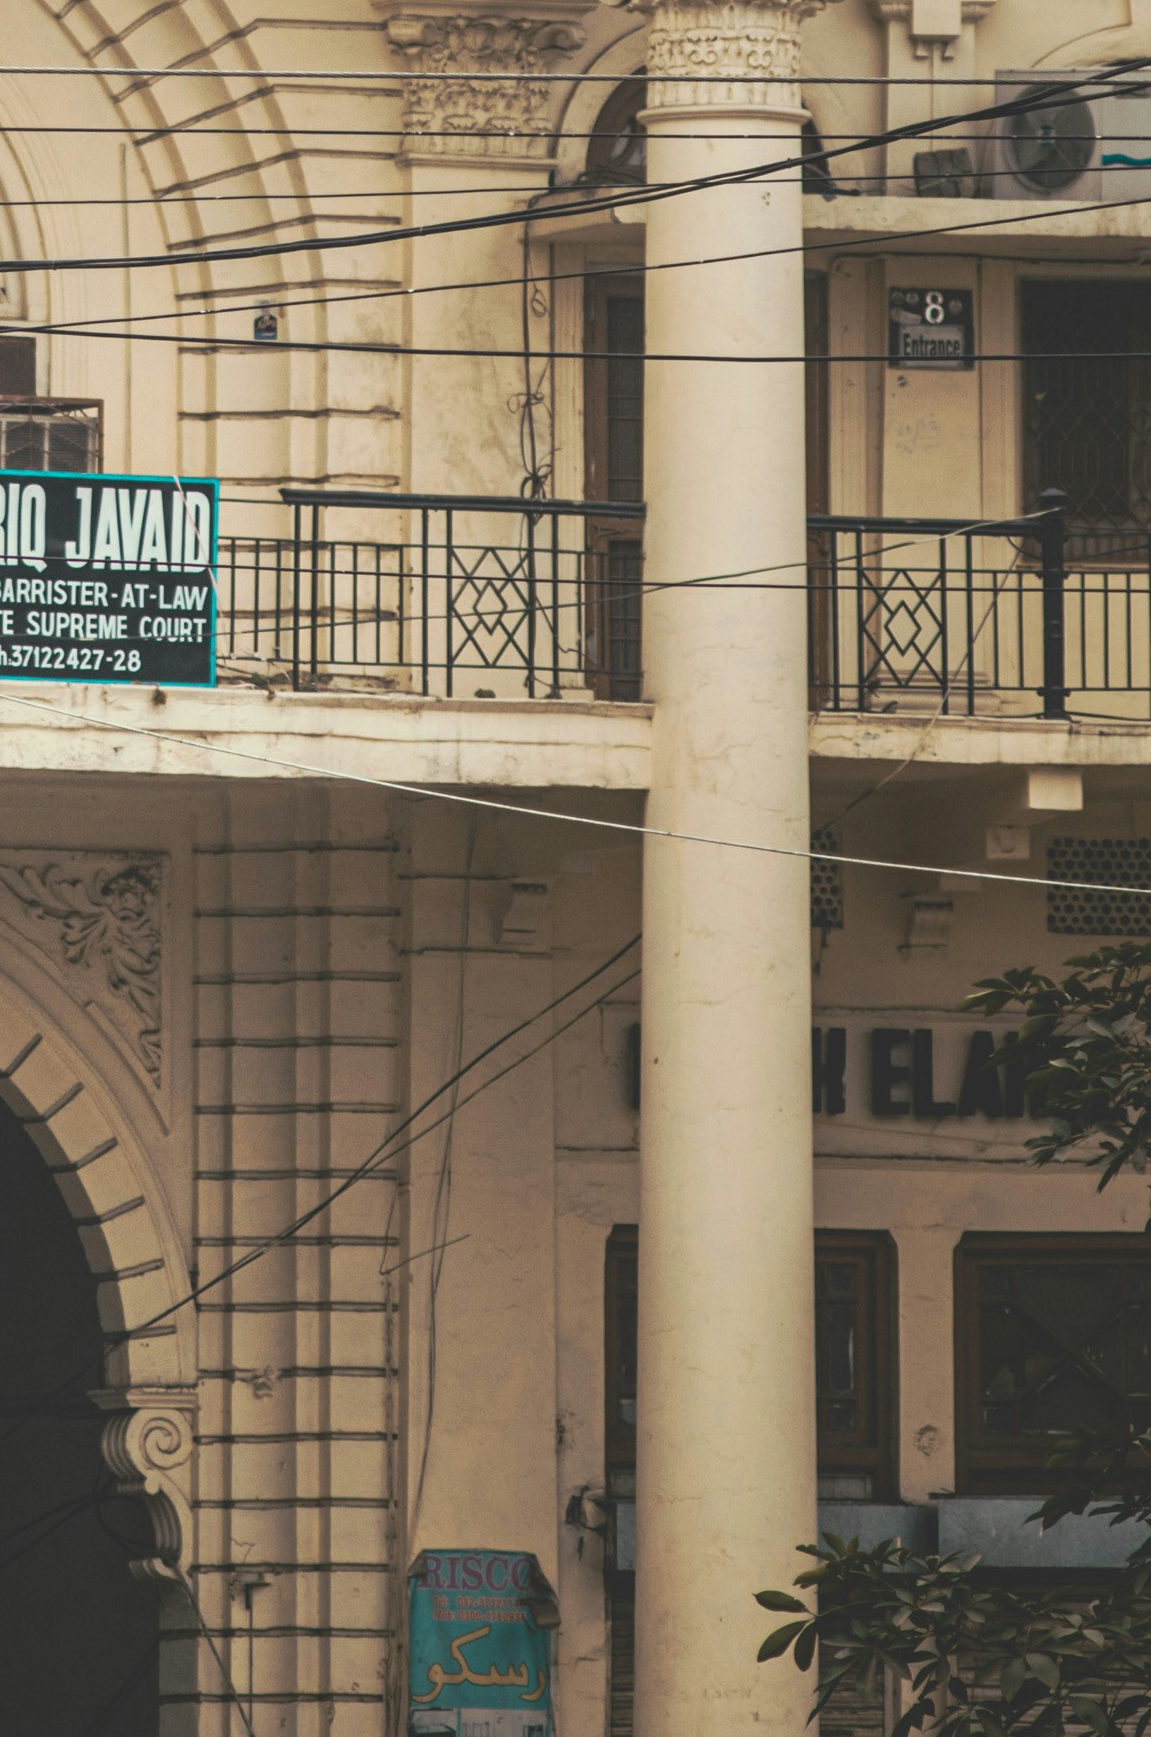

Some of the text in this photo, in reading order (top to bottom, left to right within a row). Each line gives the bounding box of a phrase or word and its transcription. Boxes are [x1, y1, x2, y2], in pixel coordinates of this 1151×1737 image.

[925, 291, 945, 324] 8
[903, 333, 961, 357] Entrance
[65, 486, 211, 574] JAVAID
[26, 612, 128, 640] SUPREME
[139, 616, 207, 643] COURT
[410, 1625, 546, 1704] رسکو
